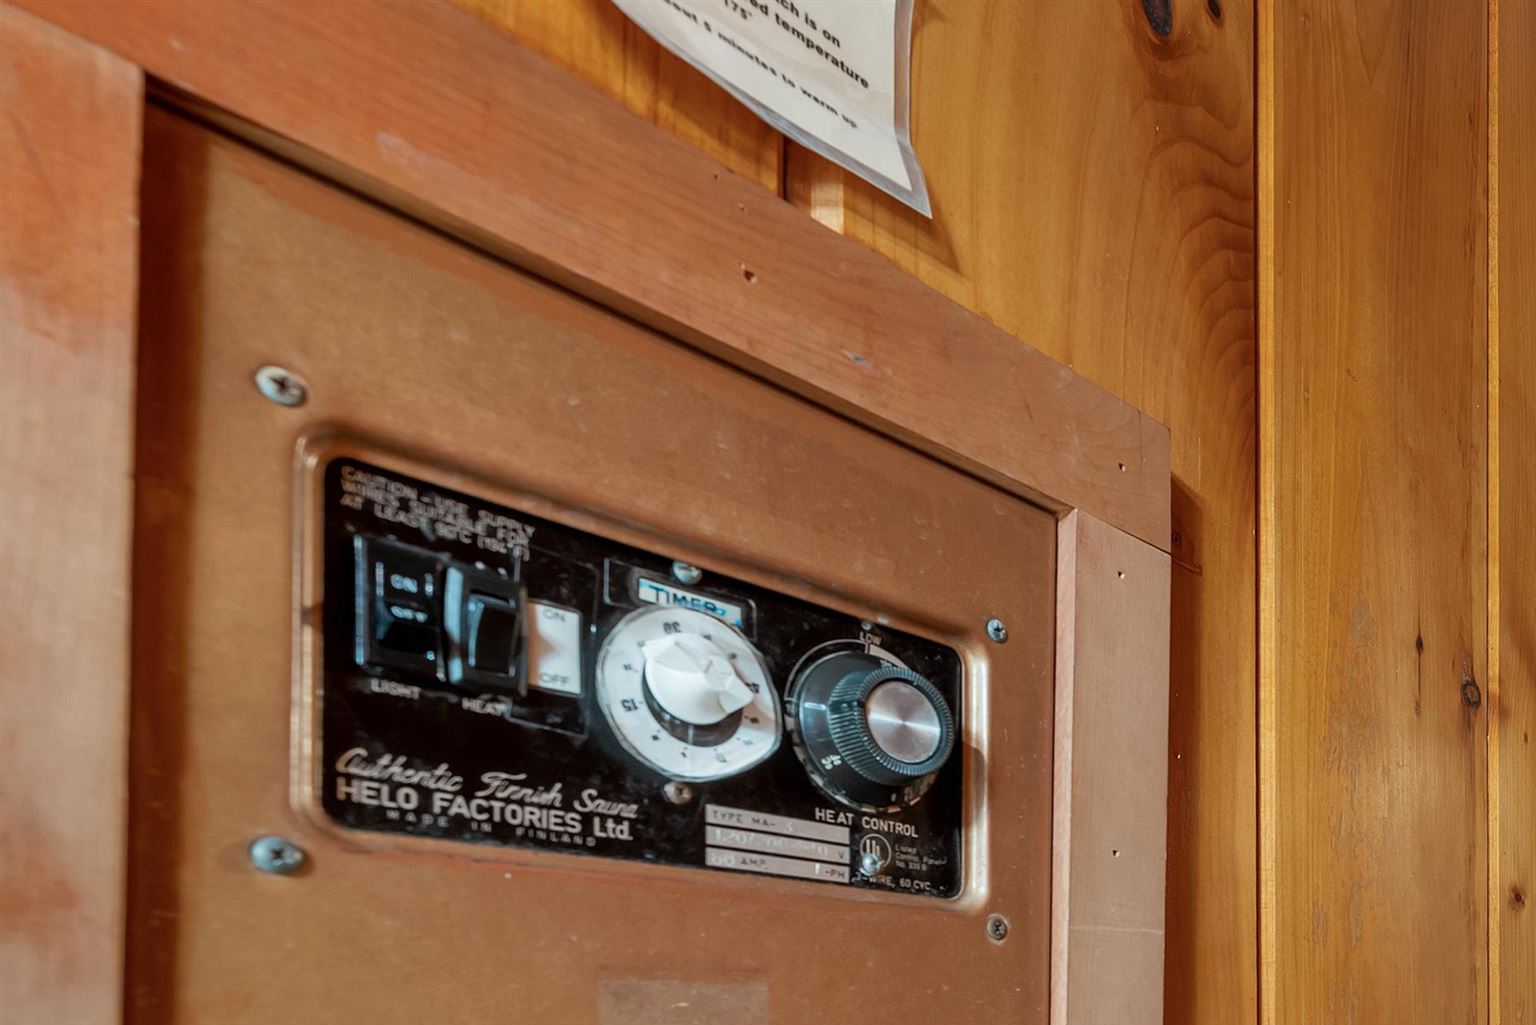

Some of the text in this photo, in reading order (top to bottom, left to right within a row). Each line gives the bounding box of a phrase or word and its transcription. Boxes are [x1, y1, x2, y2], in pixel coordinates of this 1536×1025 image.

[804, 12, 817, 30] is
[822, 29, 841, 48] on
[775, 13, 869, 88] temperature
[717, 31, 777, 76] minutes
[781, 73, 796, 88] to
[800, 86, 839, 116] warm
[859, 631, 882, 646] LOW
[370, 677, 422, 700] LIGHT
[538, 672, 570, 686] OFF
[335, 746, 639, 820] Authentic Finnish Sauna
[335, 776, 419, 811] HELO
[432, 792, 583, 835] FACTORIES
[712, 809, 743, 823] TYPE
[814, 806, 919, 838] HEAT CONTROL
[385, 808, 597, 848] MADE IN FINLAND
[899, 878, 912, 888] 60
